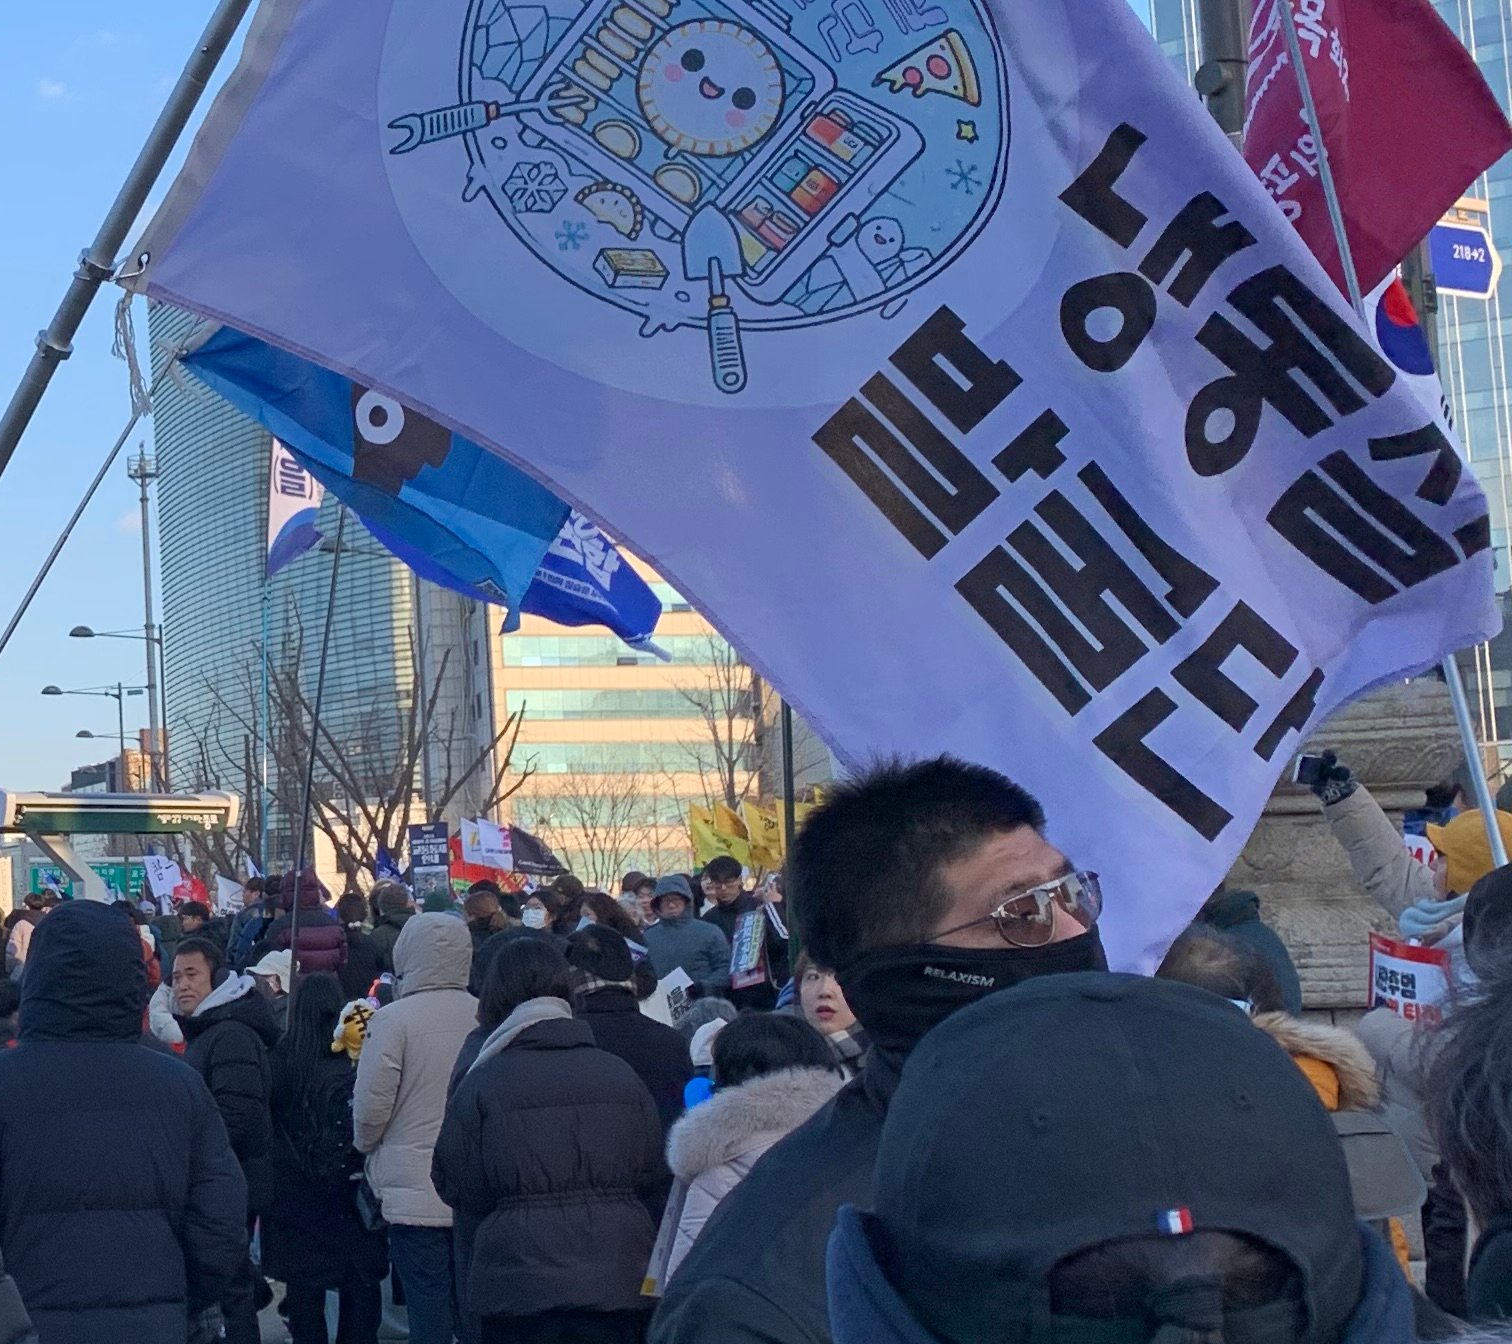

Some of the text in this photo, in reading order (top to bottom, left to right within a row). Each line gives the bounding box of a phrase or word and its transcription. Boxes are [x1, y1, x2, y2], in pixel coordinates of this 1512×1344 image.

[813, 304, 1325, 842] 발굴단
[1059, 121, 1492, 605] 냉동실
[924, 967, 995, 987] RELAXISM
